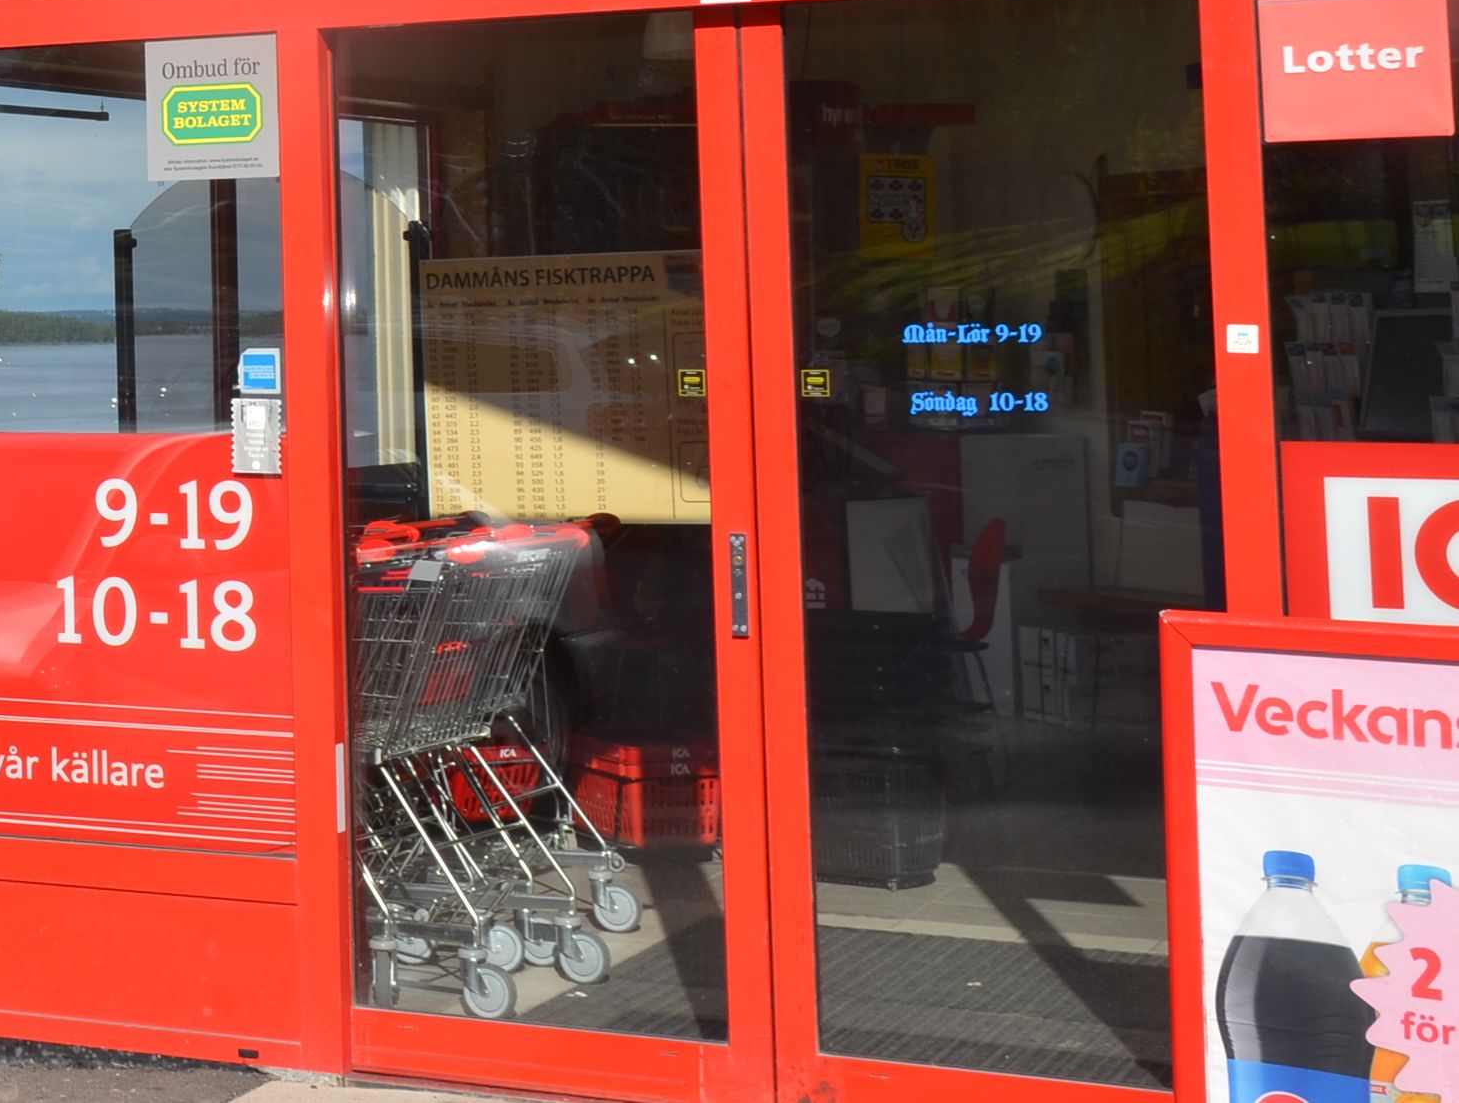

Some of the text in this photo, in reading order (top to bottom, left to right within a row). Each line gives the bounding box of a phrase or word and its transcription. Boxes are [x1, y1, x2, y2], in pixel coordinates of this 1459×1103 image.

[162, 57, 261, 79] Ombud för
[1282, 43, 1424, 74] Lotter
[177, 98, 247, 114] SYSTEM
[173, 114, 252, 129] BOLAGET
[426, 265, 656, 290] DAMMÅNS FISKTRAPPA
[902, 322, 1042, 344] Mån-Lör 9-19
[910, 391, 1049, 417] Söndag 10-18
[94, 478, 254, 551] 9-19
[56, 574, 258, 652] 10-18
[1210, 680, 1459, 751] Veckan
[499, 748, 517, 758] ICA
[672, 748, 690, 759] ICA
[51, 746, 165, 789] källare
[670, 763, 690, 775] ICA
[1410, 947, 1443, 1001] 2
[1400, 1010, 1457, 1046] för
